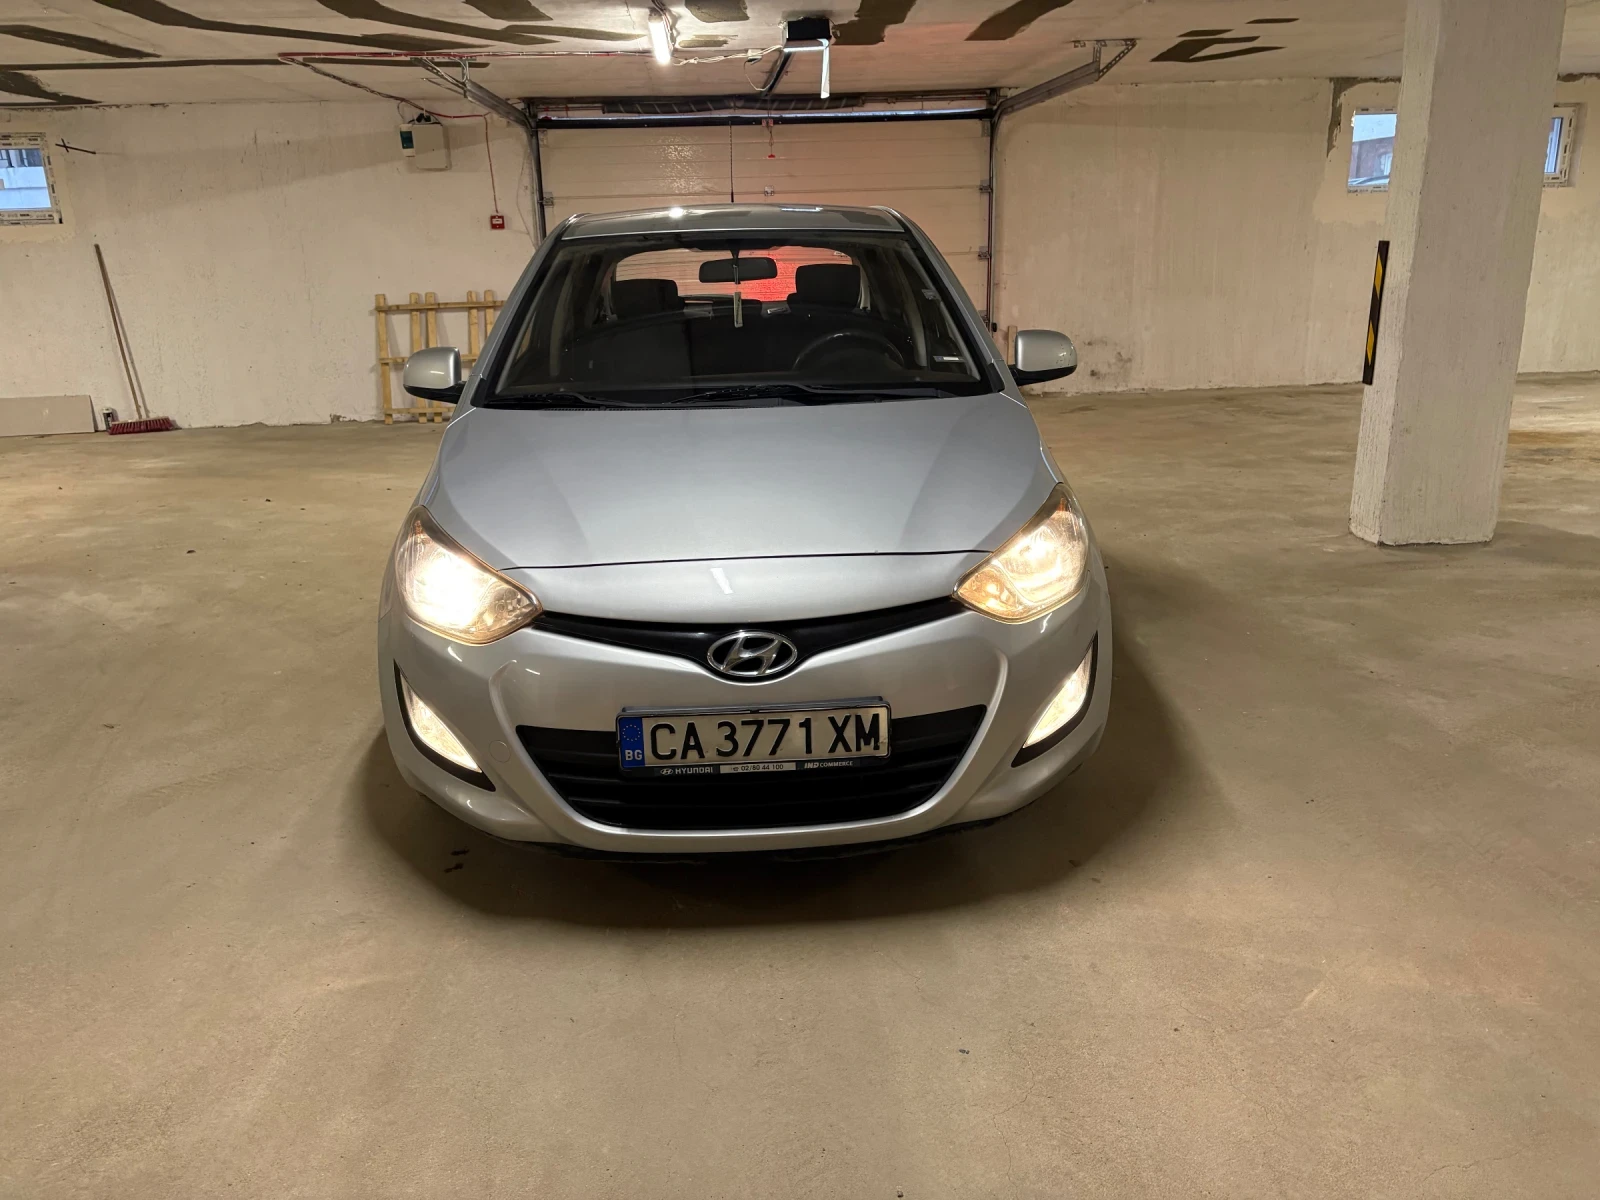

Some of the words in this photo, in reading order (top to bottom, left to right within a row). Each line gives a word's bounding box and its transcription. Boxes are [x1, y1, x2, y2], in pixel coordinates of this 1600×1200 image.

[650, 722, 706, 761] CA
[716, 718, 813, 757] 3771
[827, 713, 880, 753] XM
[625, 750, 643, 761] BG
[819, 760, 854, 768] COMMERCE
[675, 766, 713, 775] HYUNDAI
